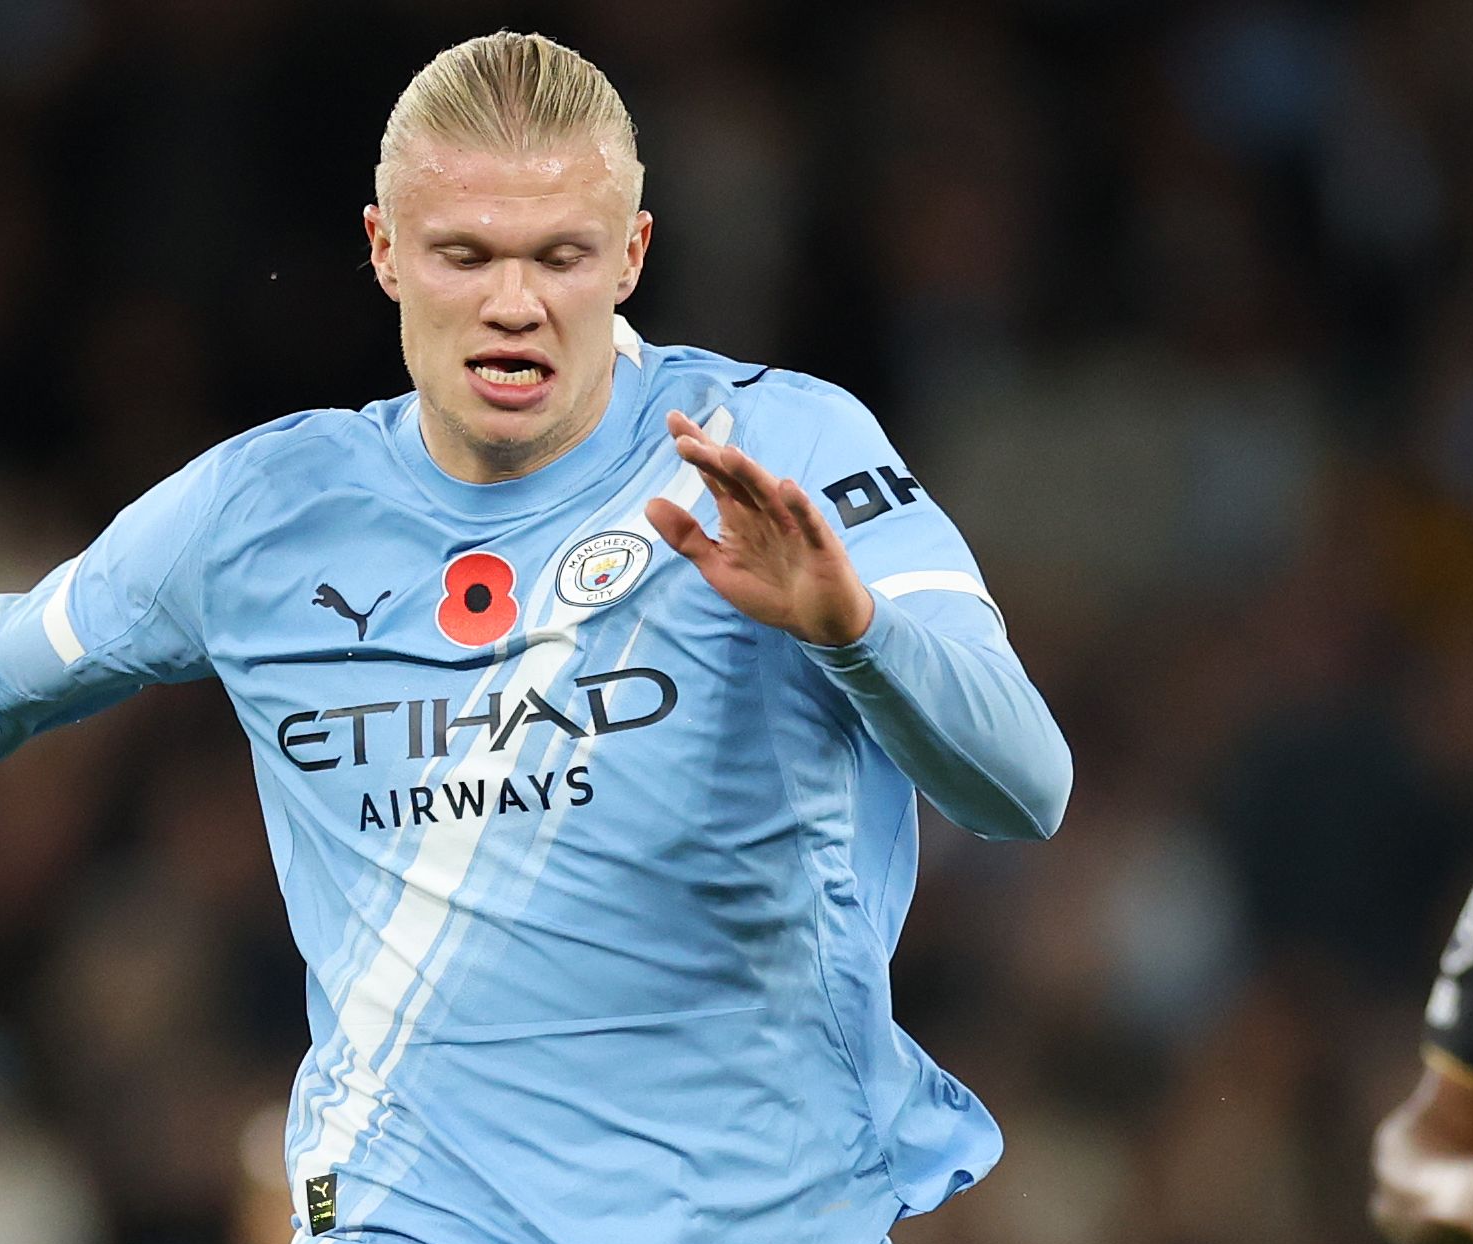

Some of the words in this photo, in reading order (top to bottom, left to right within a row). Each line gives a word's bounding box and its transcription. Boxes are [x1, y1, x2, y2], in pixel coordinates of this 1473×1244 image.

[568, 538, 644, 569] MANCHESTER
[586, 589, 613, 602] CITY
[277, 667, 679, 772] ETIHAD
[359, 766, 594, 832] AIRWAYS
